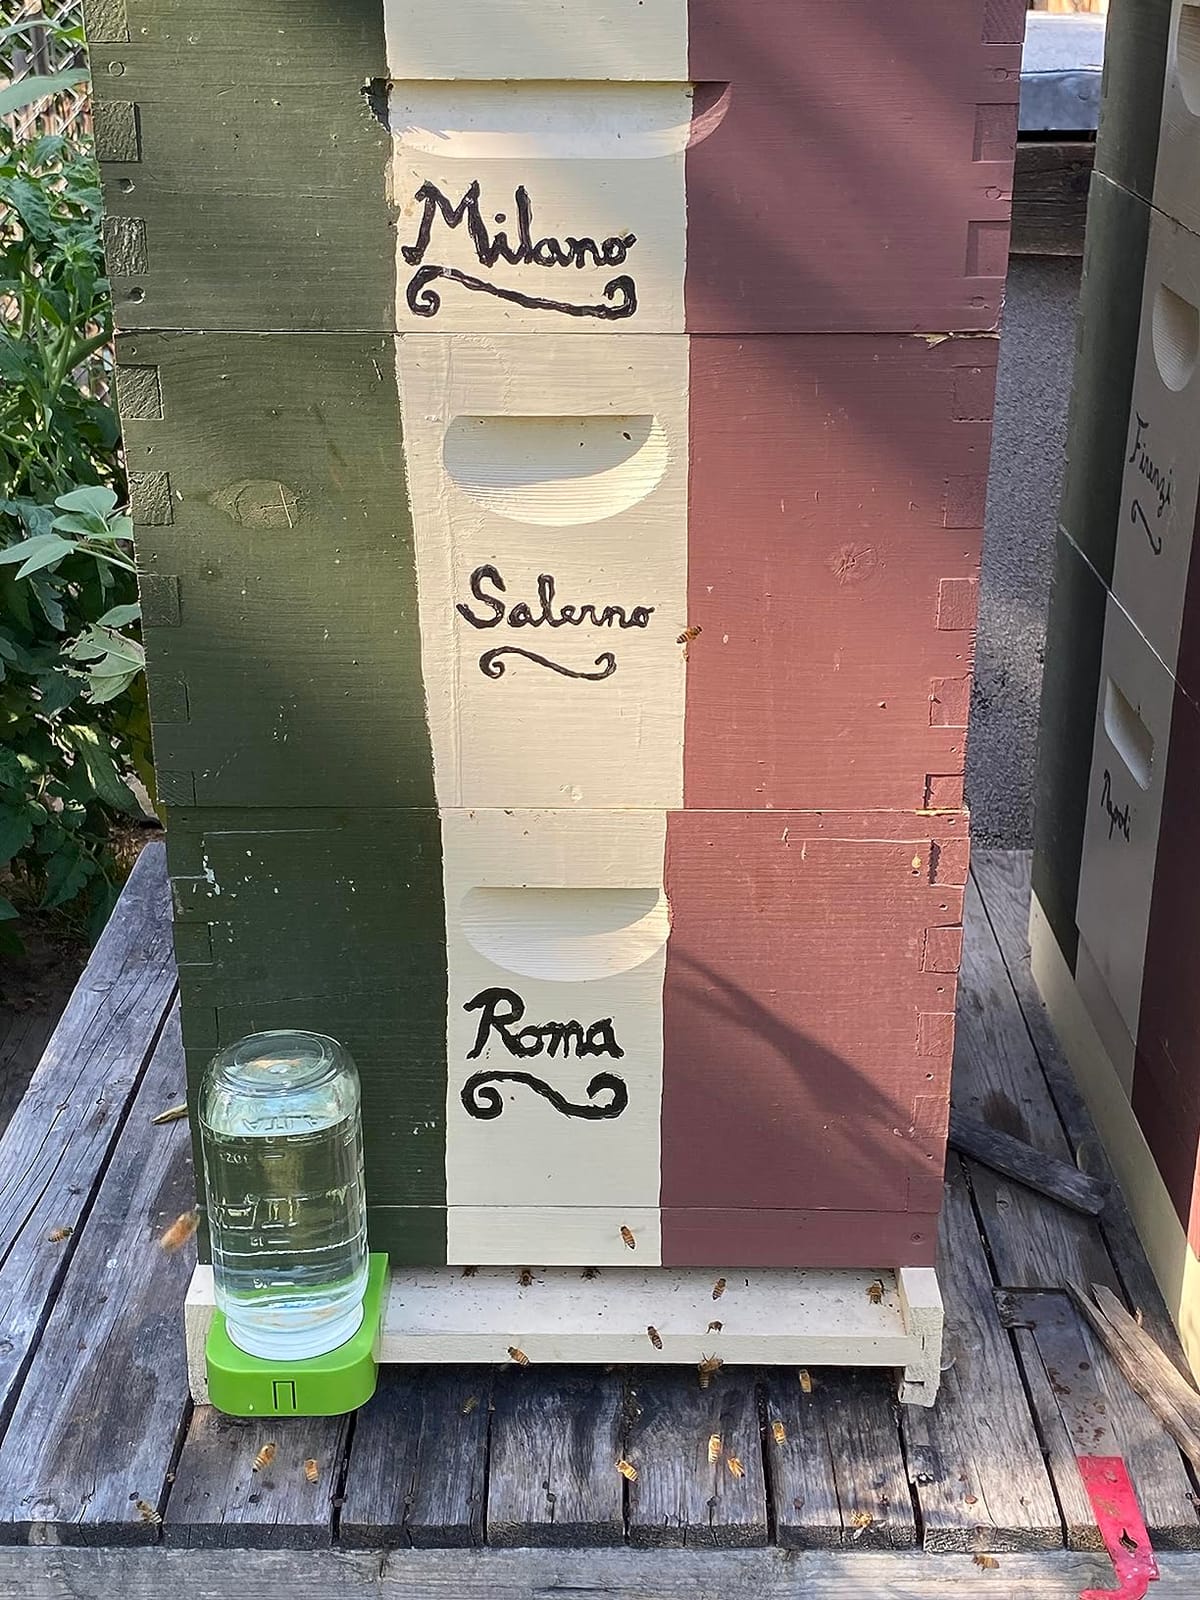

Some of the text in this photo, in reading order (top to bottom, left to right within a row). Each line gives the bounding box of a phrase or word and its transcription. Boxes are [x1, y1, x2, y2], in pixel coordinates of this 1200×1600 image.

[401, 179, 637, 269] Milano
[456, 564, 655, 629] Salerno
[463, 987, 625, 1059] Roma
